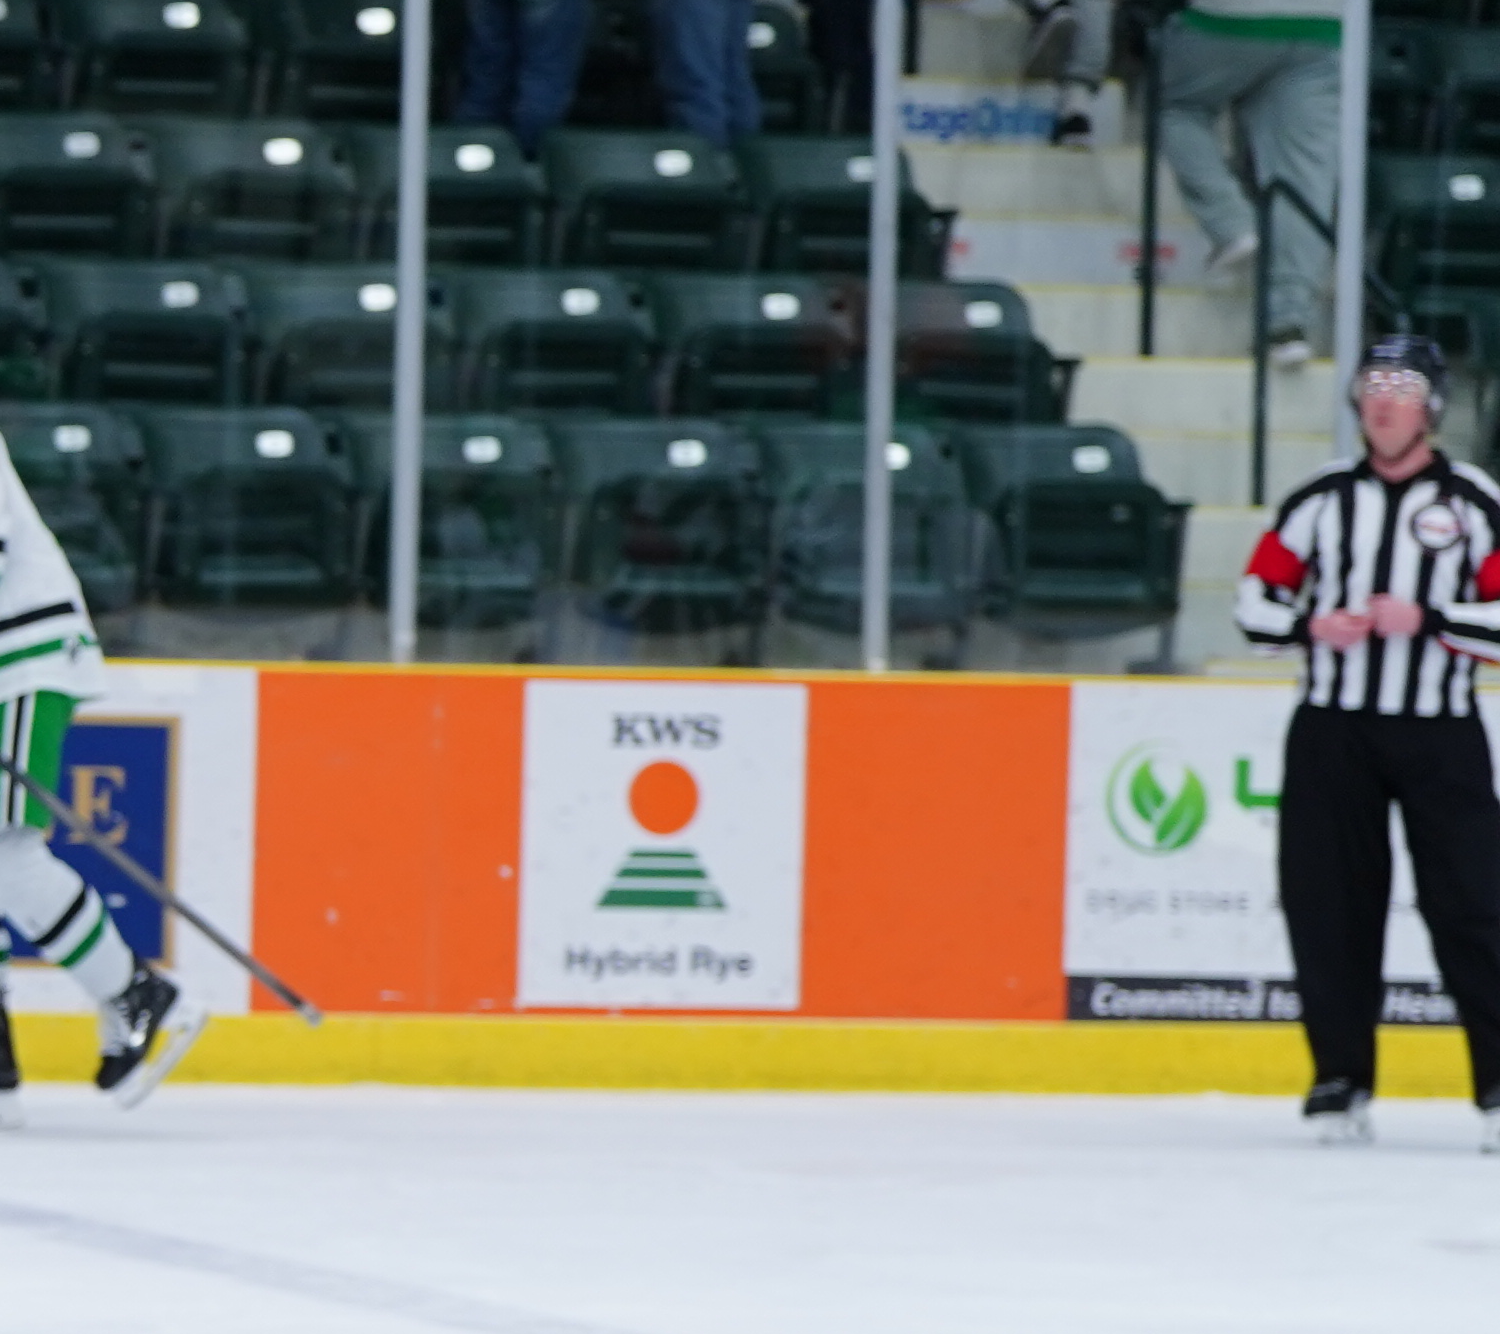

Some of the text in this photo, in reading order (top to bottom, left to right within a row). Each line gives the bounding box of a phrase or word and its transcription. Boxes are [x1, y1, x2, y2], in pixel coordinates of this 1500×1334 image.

[611, 713, 721, 749] KWS
[564, 943, 754, 984] Hybrid Rye
[1091, 981, 1264, 1020] Committed
[1268, 986, 1302, 1019] to
